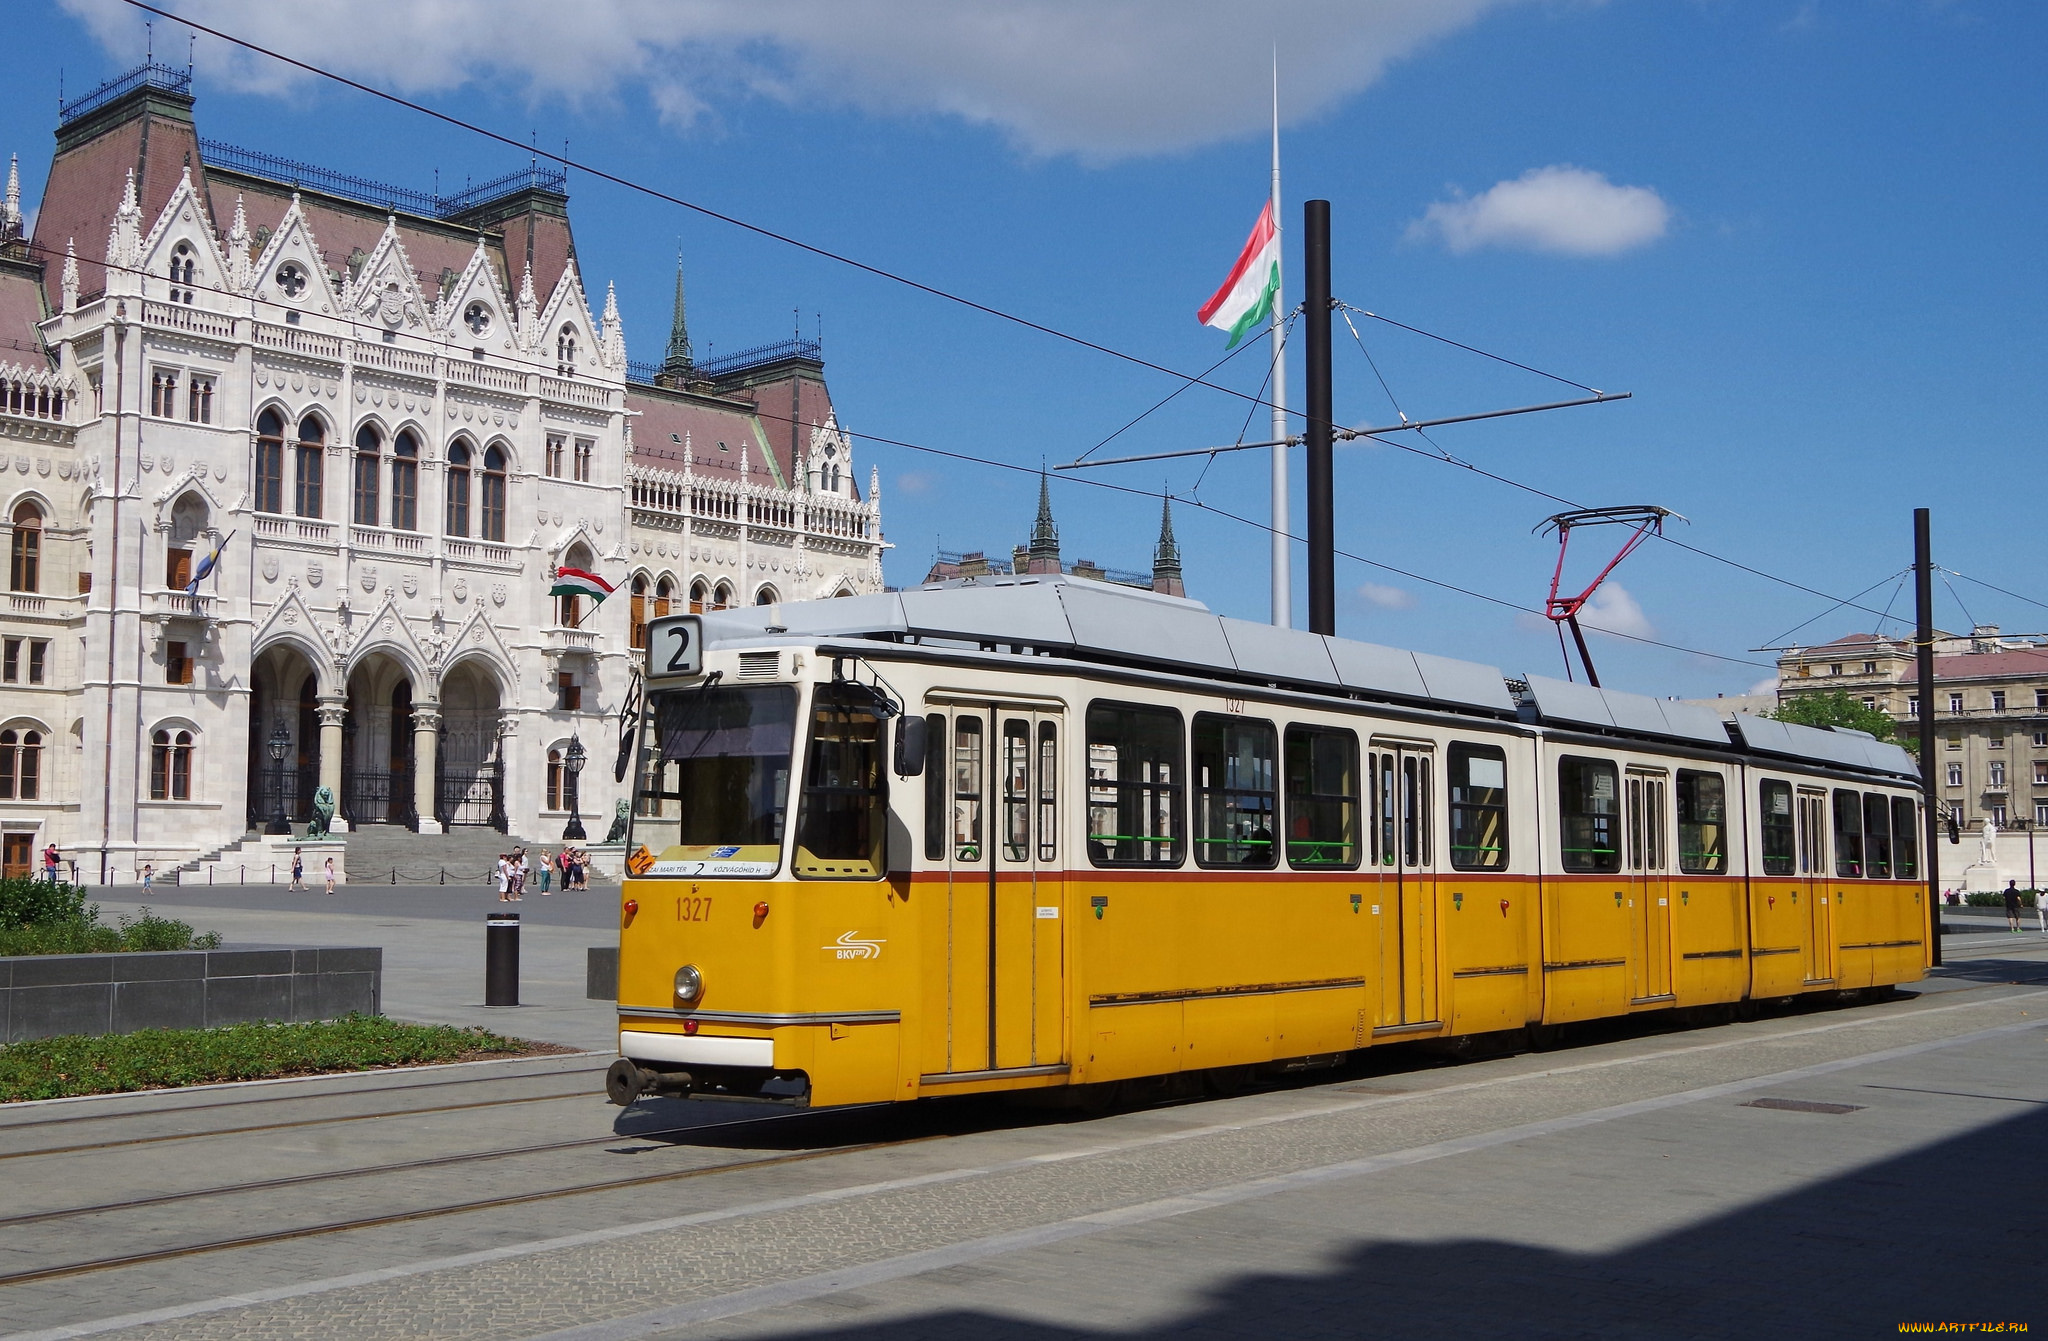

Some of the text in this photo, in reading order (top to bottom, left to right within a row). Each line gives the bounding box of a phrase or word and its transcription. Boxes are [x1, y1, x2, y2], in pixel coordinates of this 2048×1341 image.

[667, 626, 690, 672] 2
[1226, 698, 1245, 714] 1327
[1595, 773, 1600, 790] 2
[630, 847, 652, 873] F14
[693, 862, 705, 876] 2
[676, 897, 712, 922] 1327
[837, 950, 855, 959] BKV
